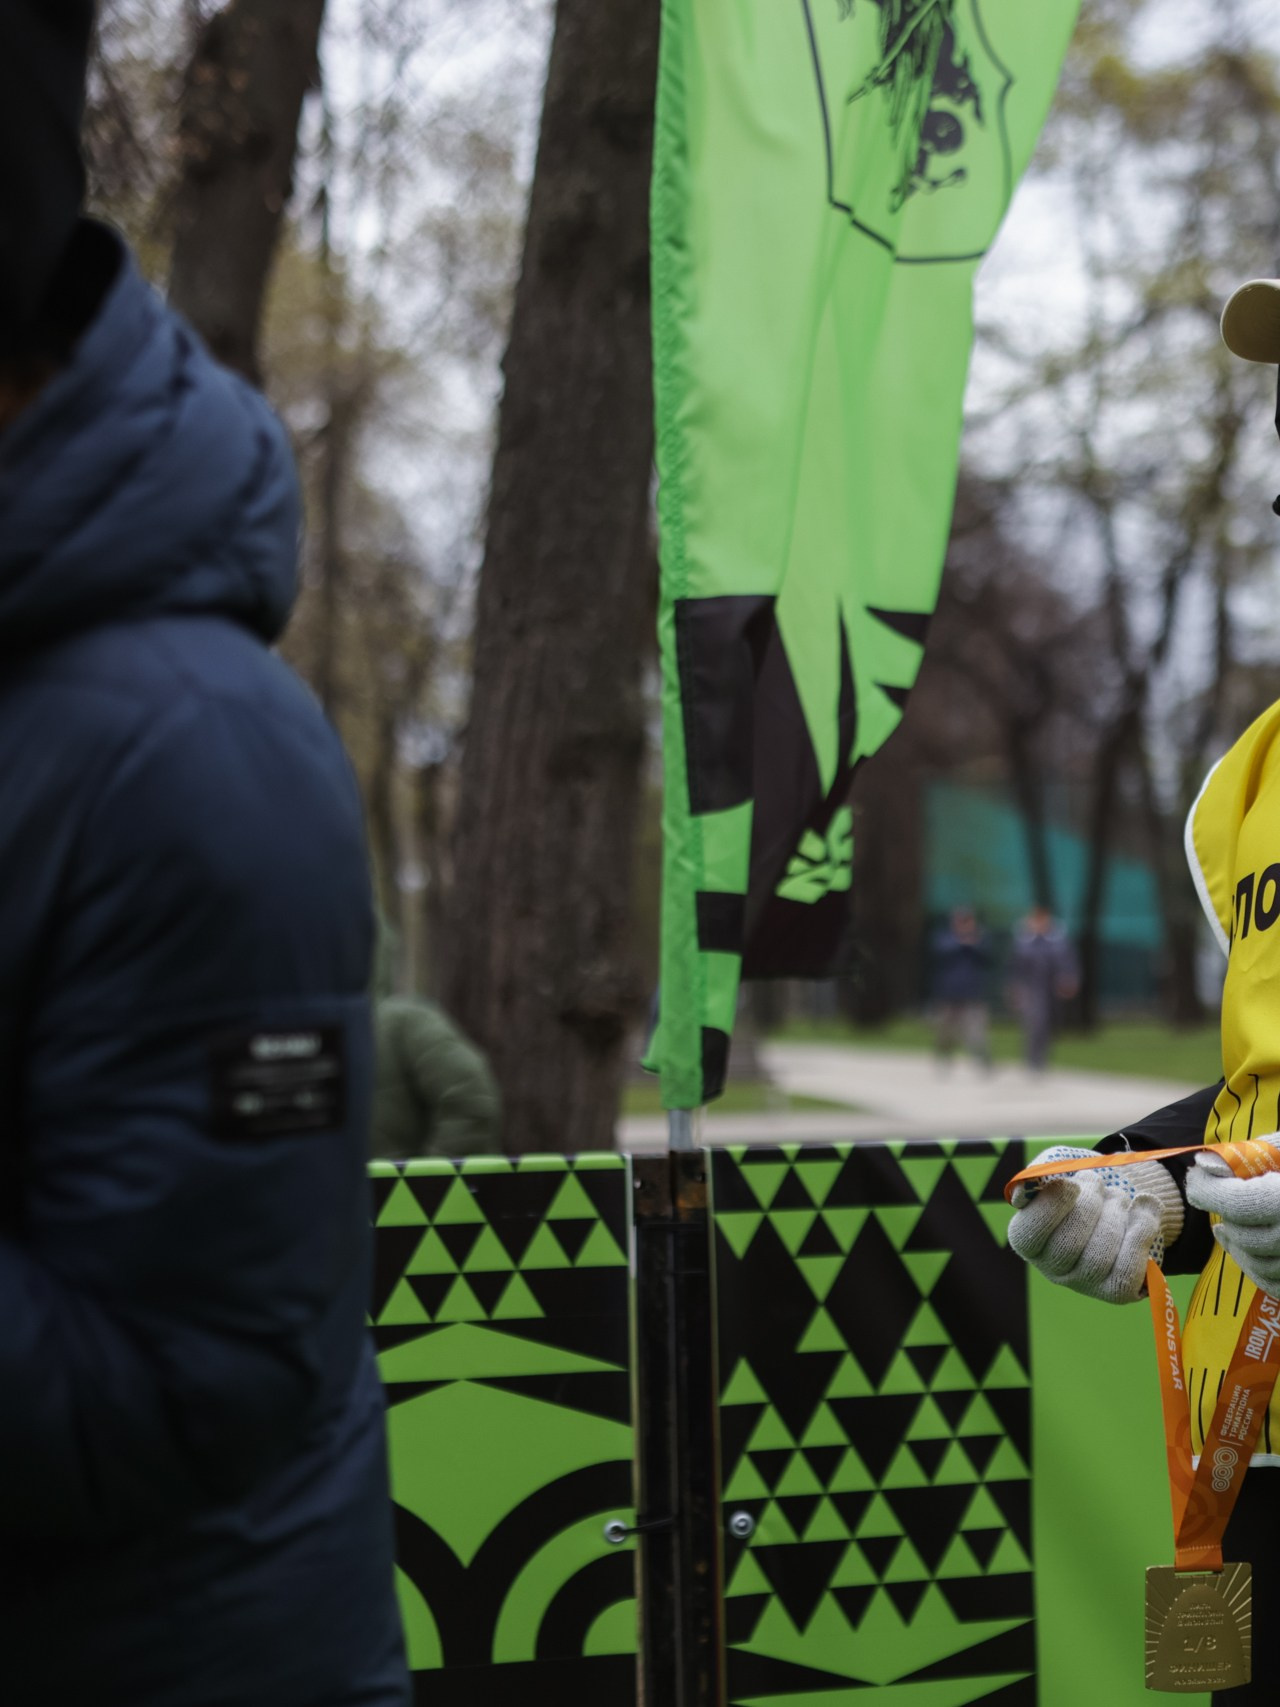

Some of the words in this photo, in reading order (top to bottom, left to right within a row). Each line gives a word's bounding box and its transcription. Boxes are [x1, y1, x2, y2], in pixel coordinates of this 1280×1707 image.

[1165, 1288, 1183, 1390] IRONSTAR
[1244, 1326, 1268, 1360] IRON
[1260, 1292, 1280, 1316] ST
[1220, 1384, 1242, 1436] ФЕДЕРАЦИЯ
[1229, 1389, 1250, 1437] ТРИАТЛОНА
[1238, 1408, 1254, 1440] РОССИИ
